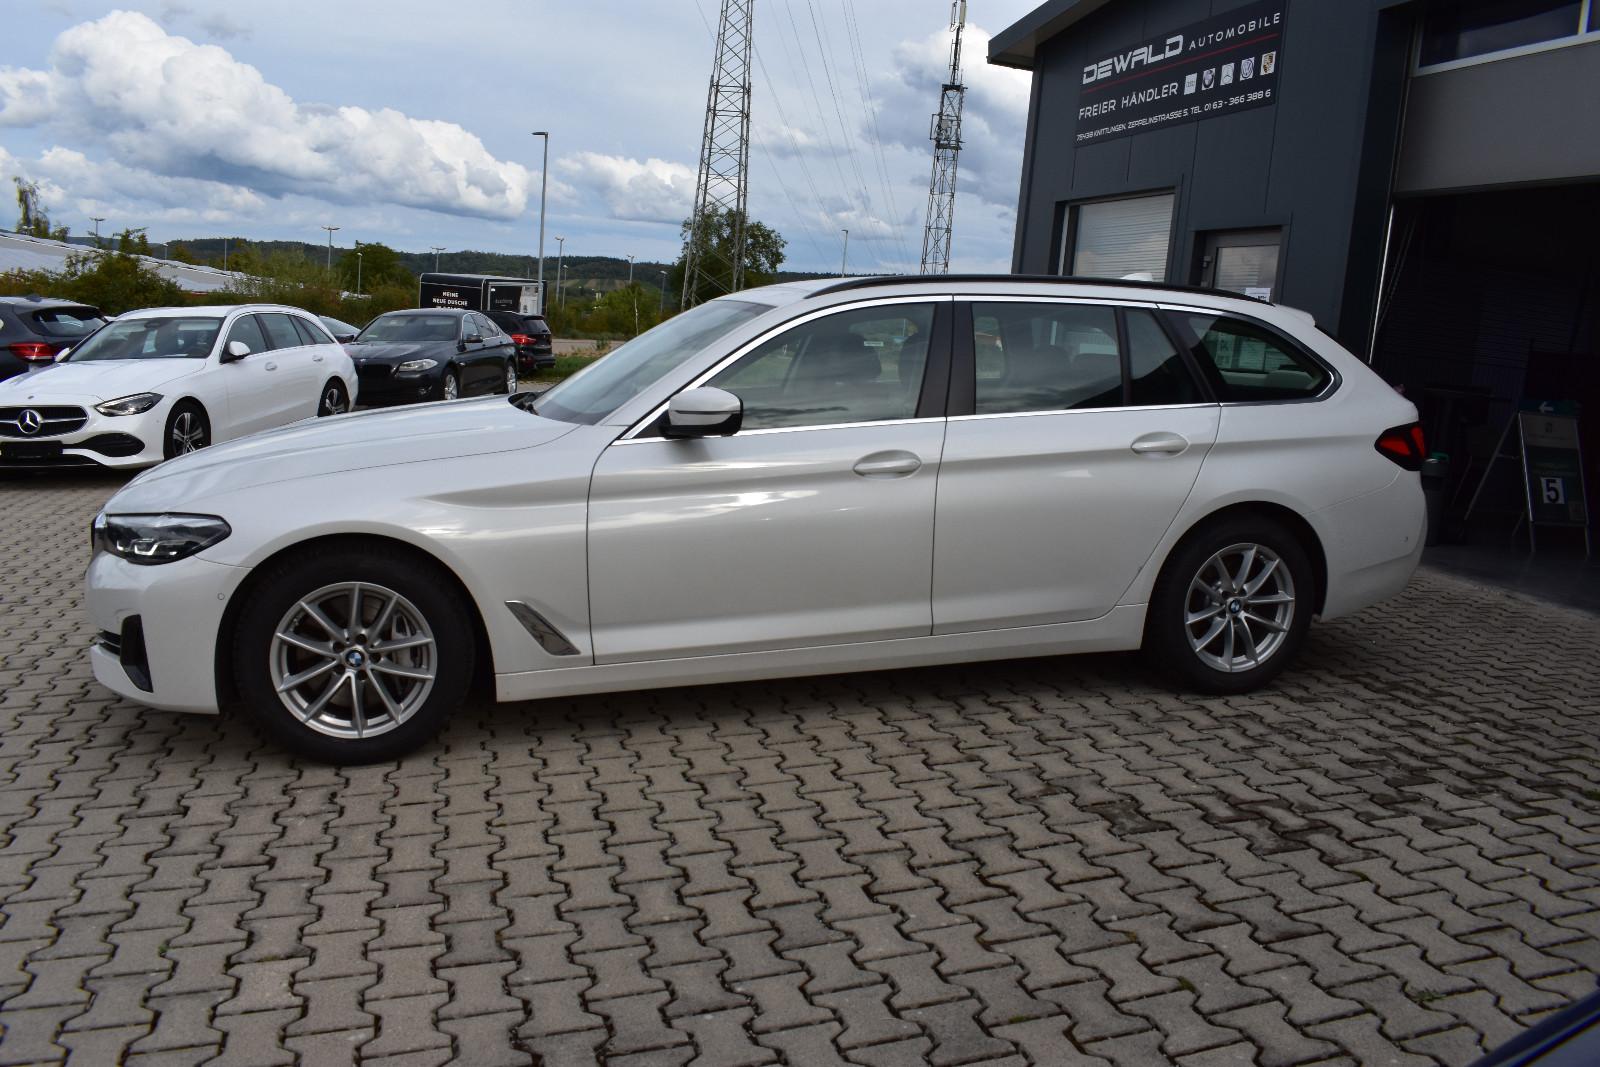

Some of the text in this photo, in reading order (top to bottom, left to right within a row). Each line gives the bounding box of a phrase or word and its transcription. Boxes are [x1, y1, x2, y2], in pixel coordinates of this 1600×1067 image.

[1082, 12, 1281, 84] DEWALD AUTOMOBILE
[1078, 82, 1179, 120] FREIER HÄNDLER
[1546, 478, 1559, 503] 5
